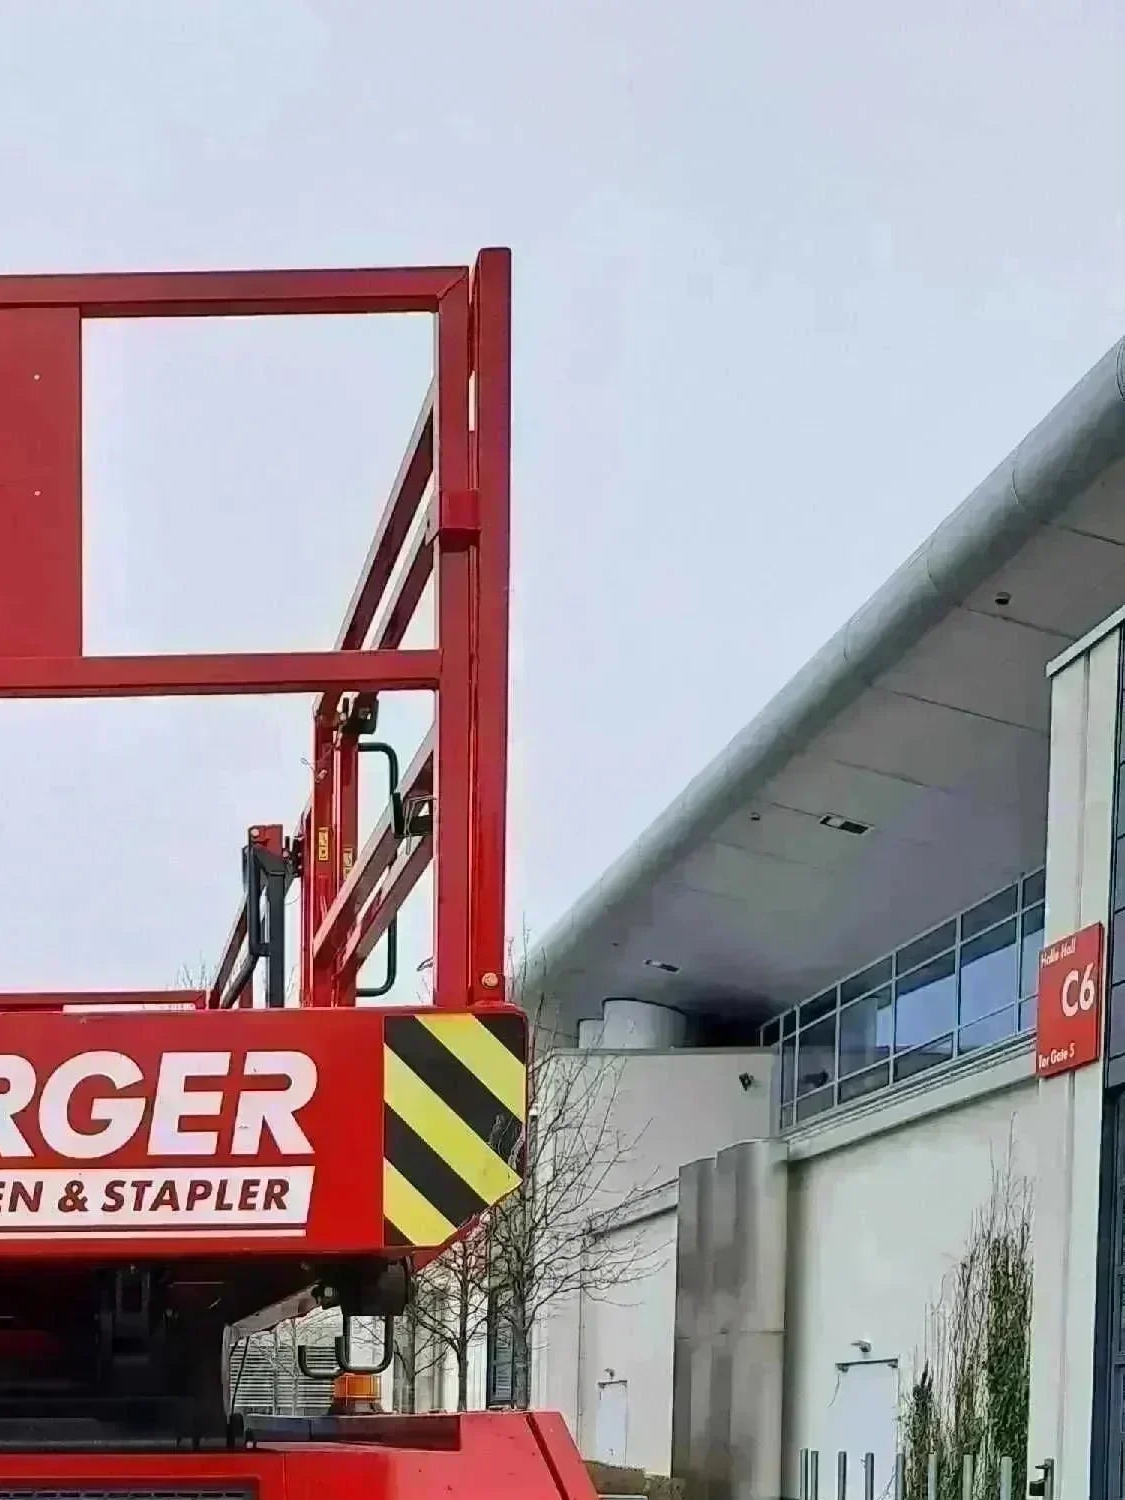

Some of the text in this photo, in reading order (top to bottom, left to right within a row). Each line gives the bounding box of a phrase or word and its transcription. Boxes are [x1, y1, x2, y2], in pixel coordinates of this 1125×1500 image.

[1062, 962, 1095, 1017] C6
[57, 1178, 89, 1213] &
[101, 1178, 290, 1213] STAPLER
